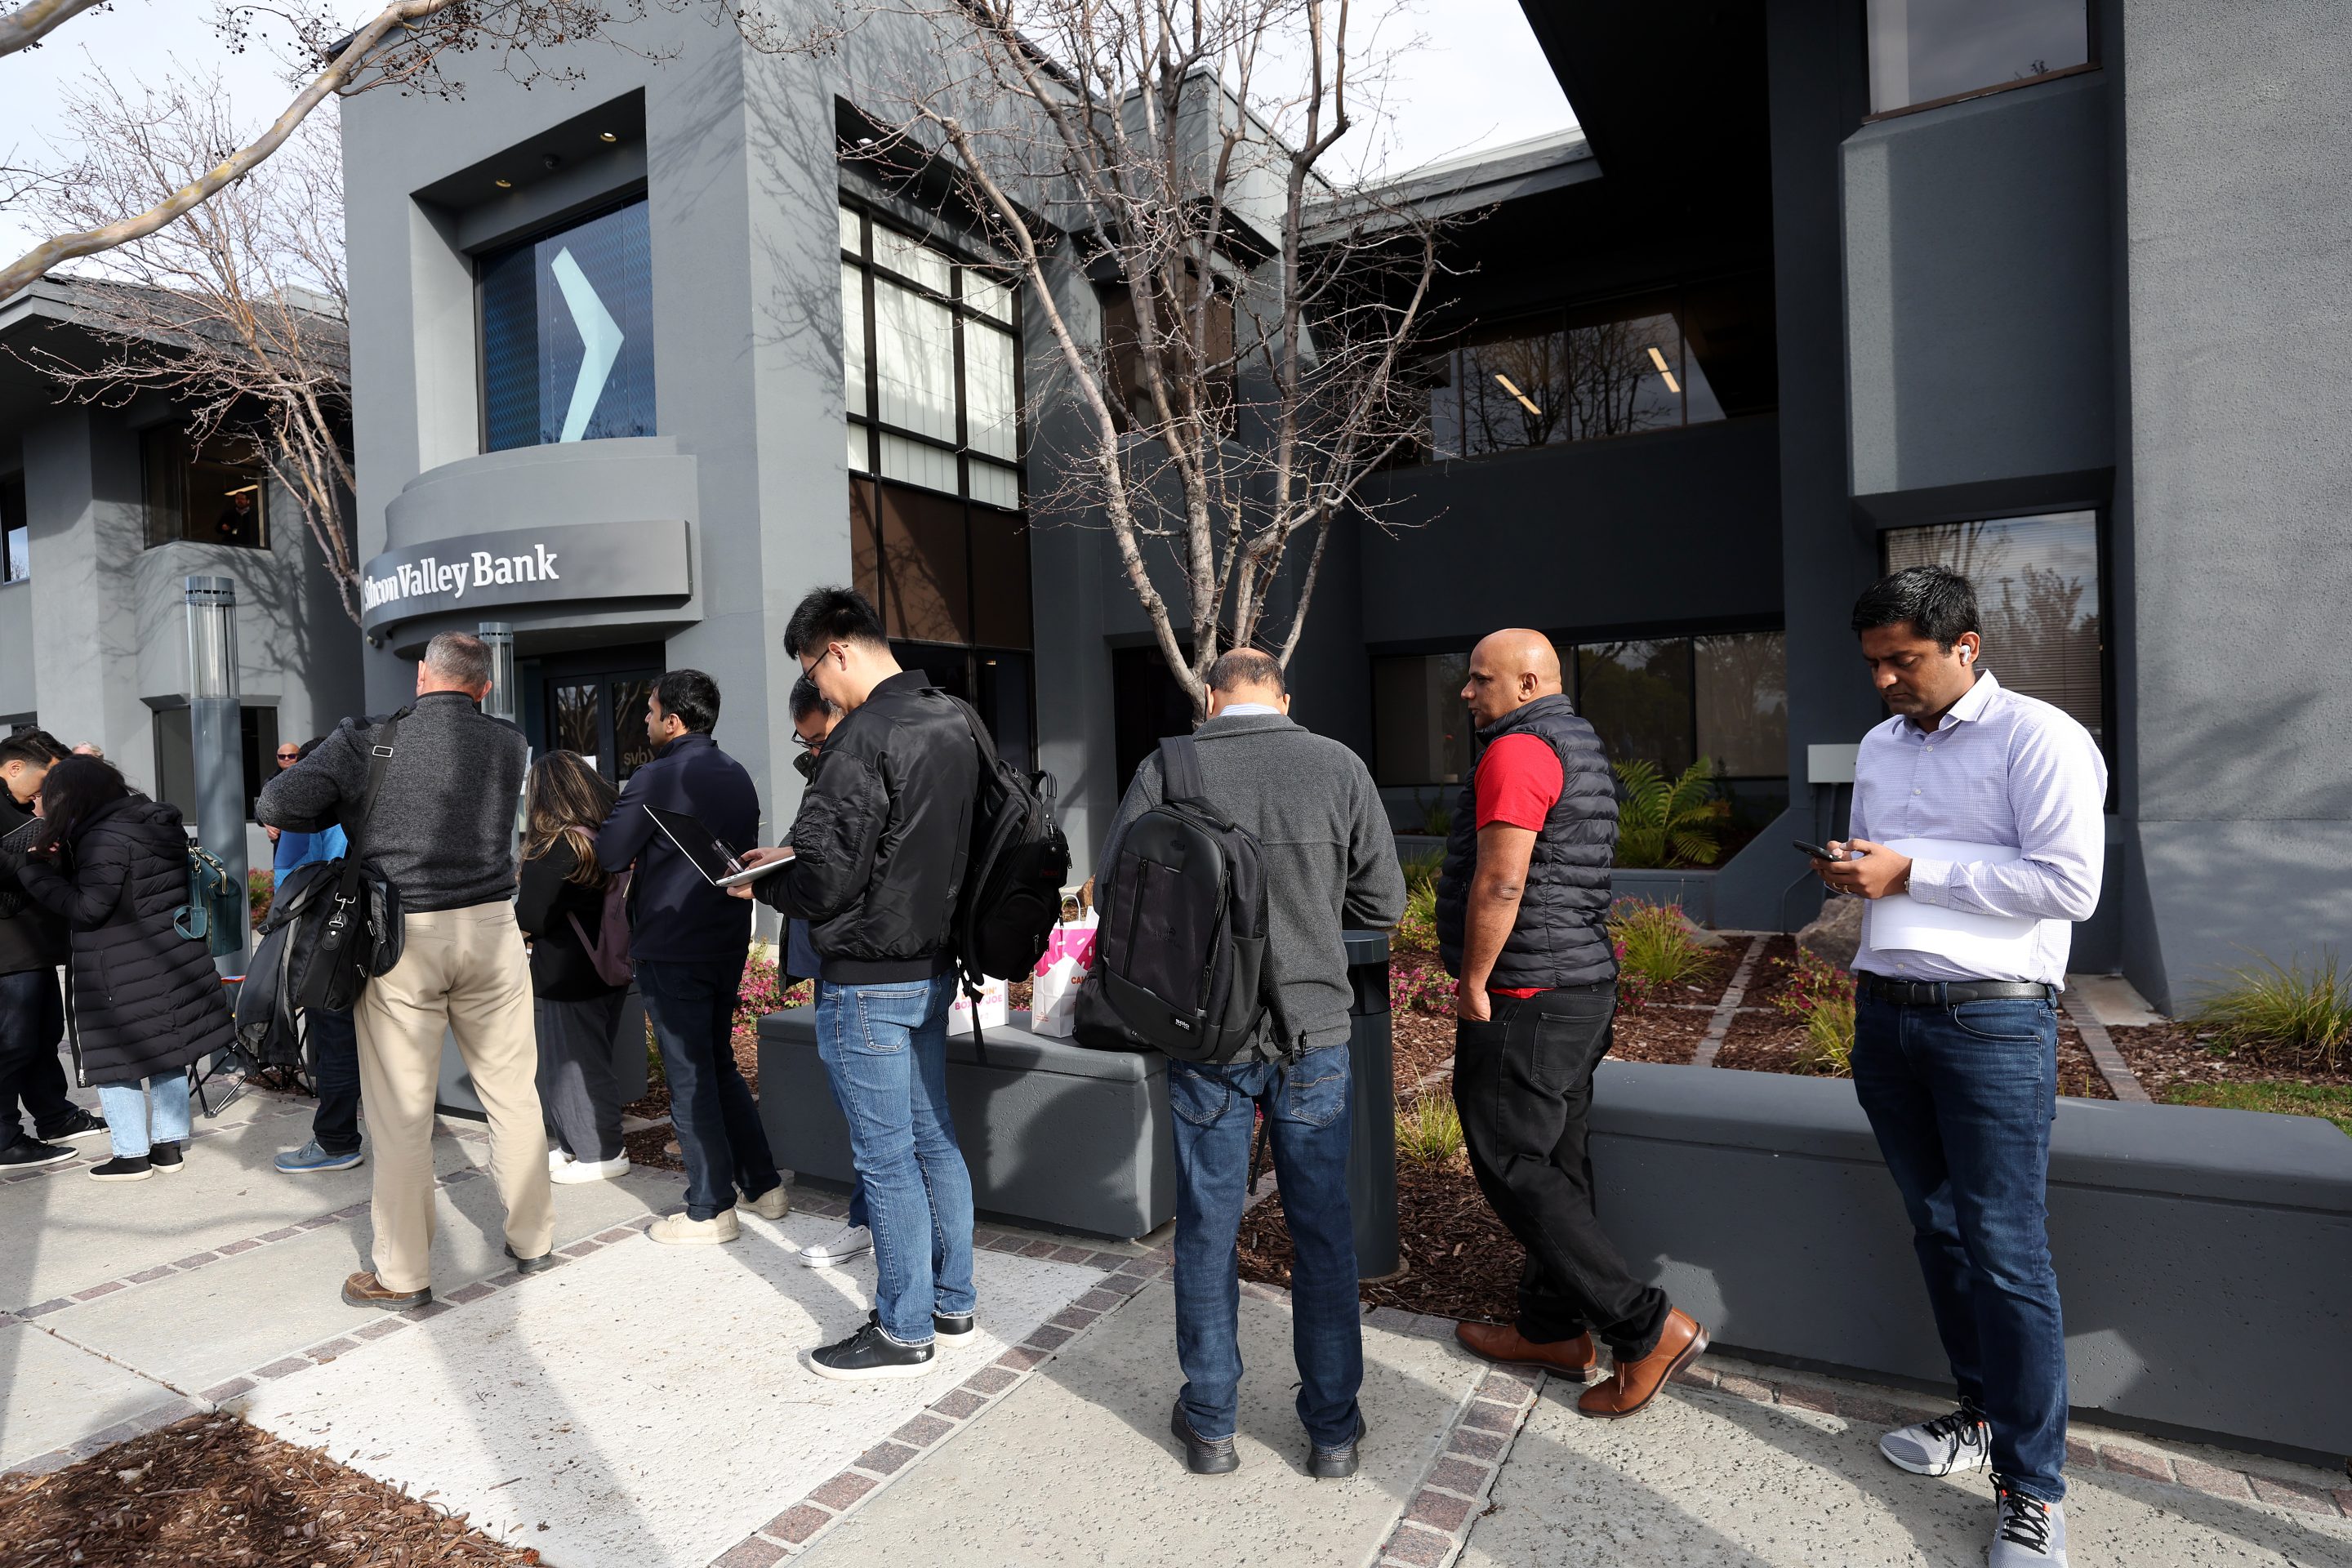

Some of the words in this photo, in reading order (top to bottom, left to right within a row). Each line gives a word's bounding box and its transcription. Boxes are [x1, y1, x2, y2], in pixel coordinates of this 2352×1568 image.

[396, 557, 469, 599] Valley
[470, 543, 559, 587] Bank
[986, 995, 1003, 1004] JOE
